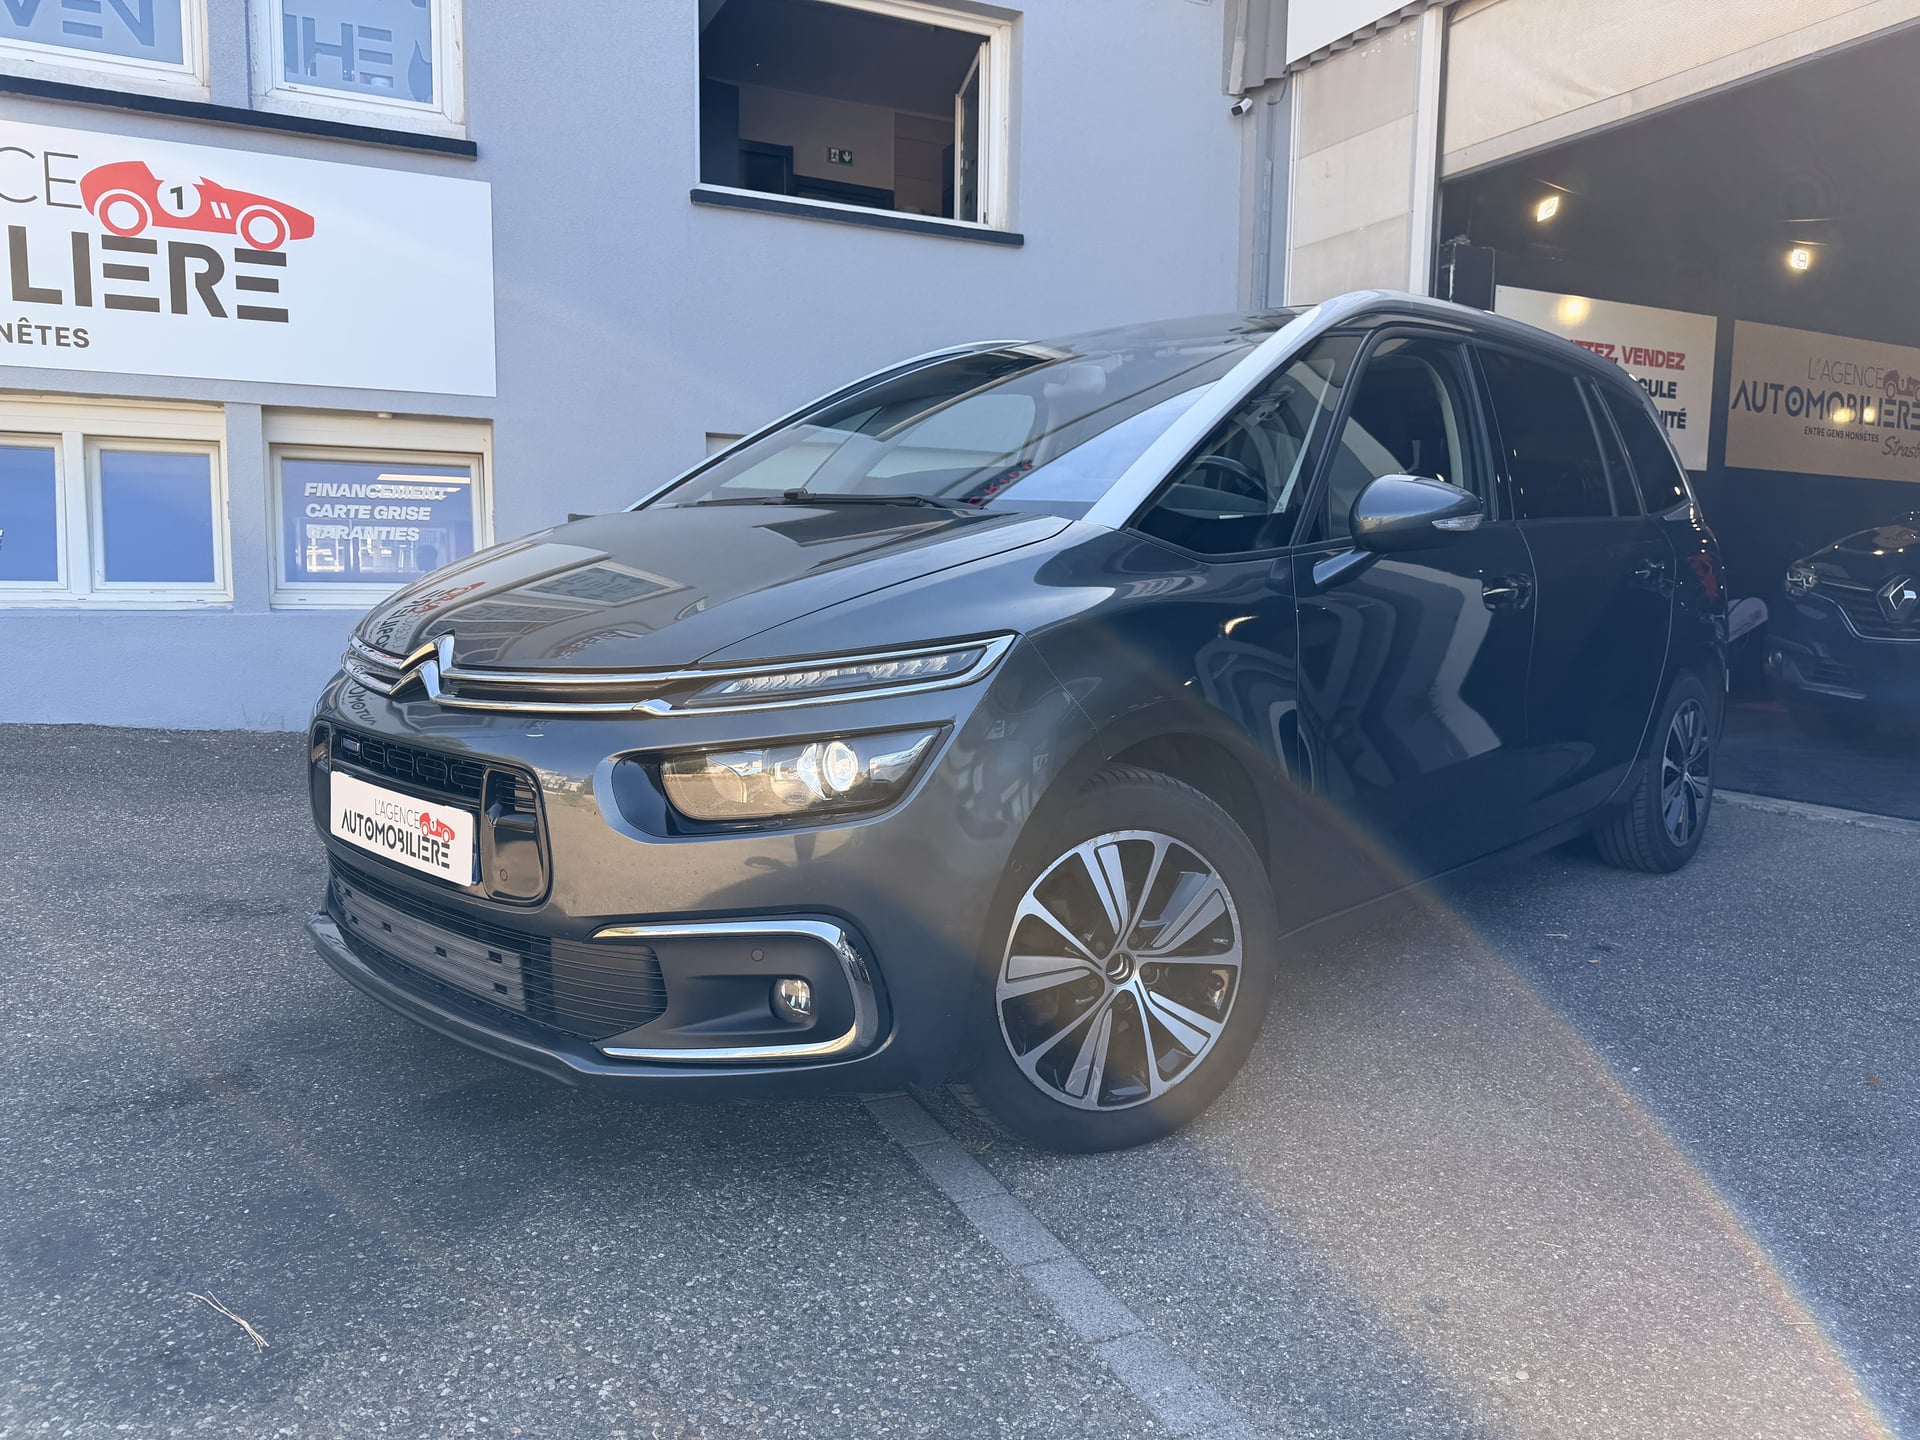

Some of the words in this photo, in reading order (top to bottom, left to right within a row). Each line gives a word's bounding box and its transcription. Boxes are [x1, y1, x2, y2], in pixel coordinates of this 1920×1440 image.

[8, 224, 289, 323] LIERE
[1621, 345, 1686, 371] VENDEZ
[1807, 357, 1885, 390] L'AGENCE
[1731, 378, 1920, 431] AUTOMOBILIERE
[1660, 408, 1687, 430] ITÉ
[1804, 426, 1825, 437] ENTRE
[1826, 428, 1844, 439] GENS
[1845, 430, 1880, 443] HONNÊTES
[304, 482, 448, 500] FINANCEMENT
[305, 503, 372, 518] CARTE
[373, 505, 432, 521] GRISE
[306, 525, 420, 542] GARANTIES
[374, 798, 420, 830] L'AGENCE
[341, 808, 450, 869] AUTOMOBILIERE
